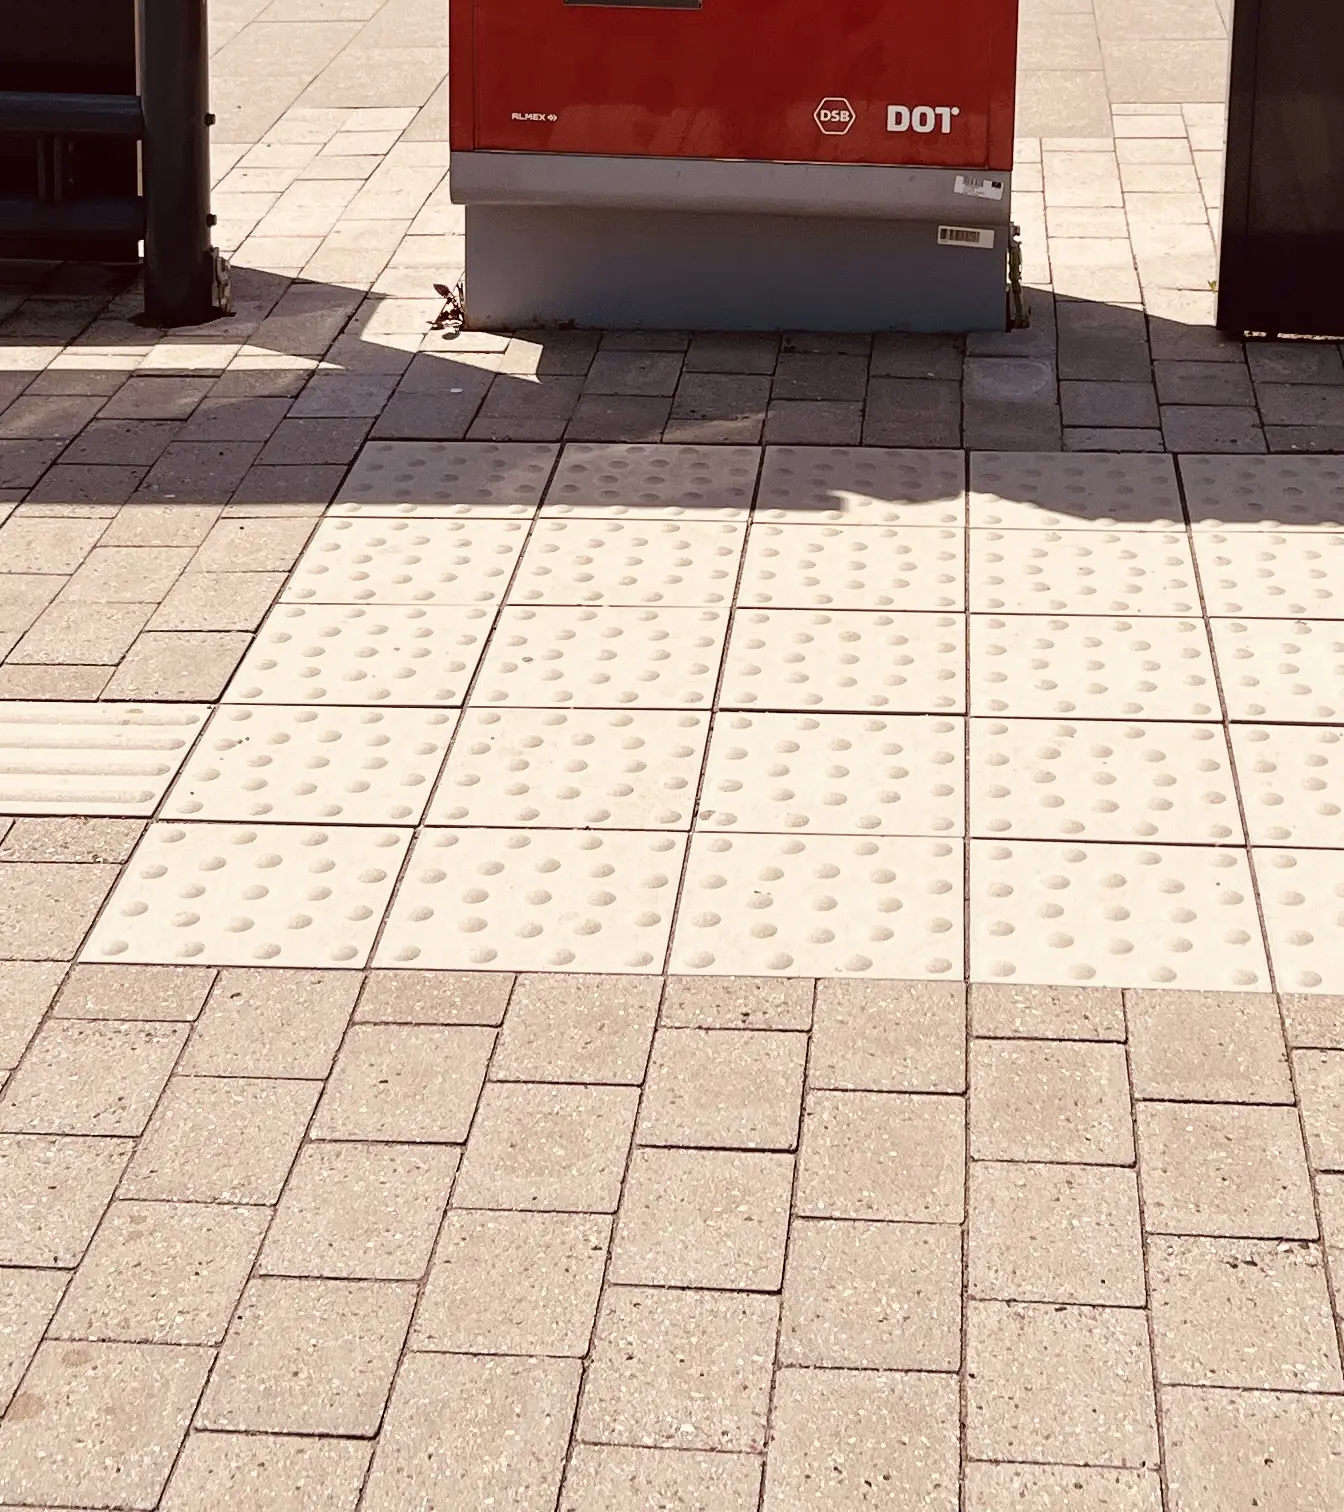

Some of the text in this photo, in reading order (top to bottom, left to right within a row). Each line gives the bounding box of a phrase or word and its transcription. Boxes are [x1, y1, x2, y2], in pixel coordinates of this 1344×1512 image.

[512, 113, 545, 121] ALMEX
[820, 110, 850, 122] DSB
[887, 105, 951, 133] DOT
